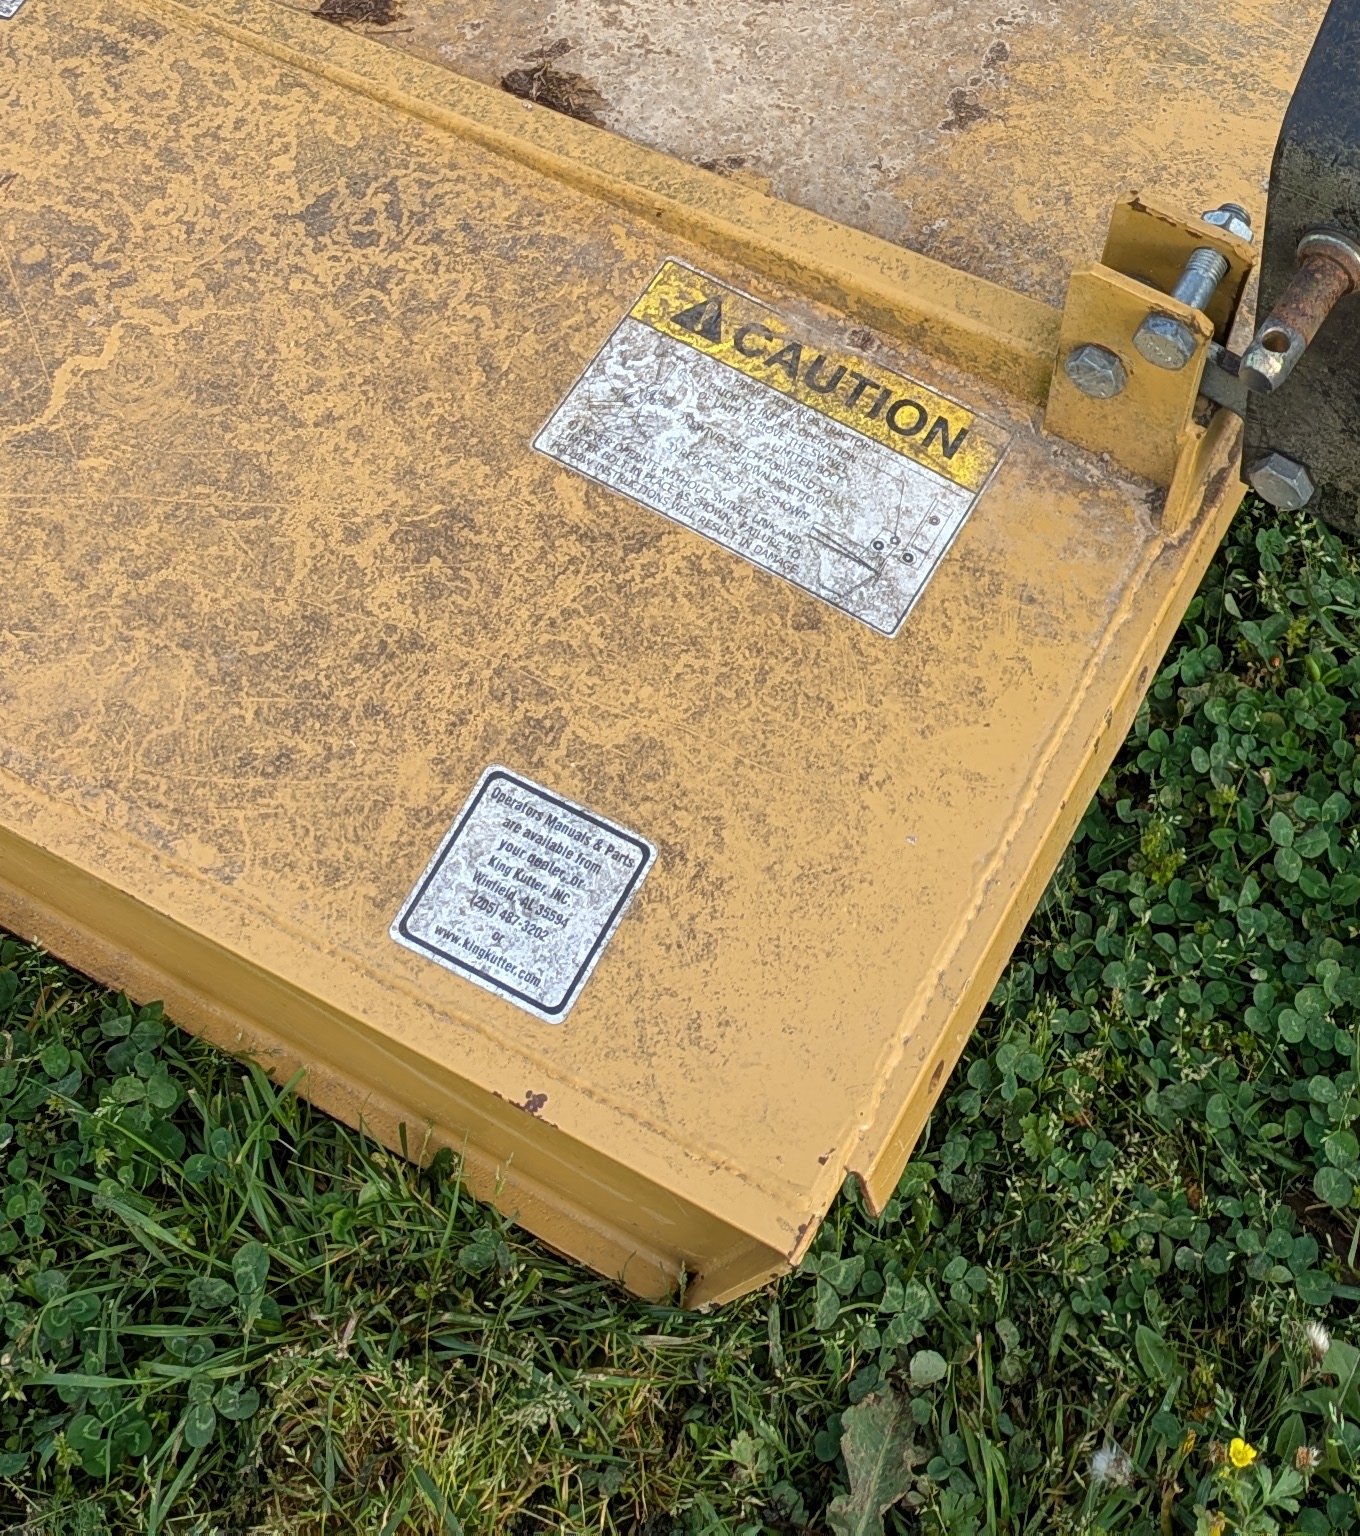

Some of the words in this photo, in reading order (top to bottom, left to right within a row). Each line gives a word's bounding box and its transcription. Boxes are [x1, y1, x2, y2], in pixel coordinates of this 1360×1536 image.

[728, 319, 970, 460] CAUTION
[734, 378, 766, 399] FRONT
[772, 398, 820, 425] TOWARDS
[824, 424, 870, 450] TRACTOR
[697, 392, 712, 403] OF
[744, 416, 785, 439] REMOVE
[787, 437, 808, 451] THE
[811, 450, 848, 472] SWIVEL
[708, 383, 738, 402] PRIOR
[742, 400, 756, 411] TO
[759, 408, 795, 430] INITIAL
[798, 429, 857, 462] OPERATION
[580, 426, 611, 446] NEVER
[614, 443, 659, 470] OPERATE
[661, 468, 708, 496] WITHOUT
[712, 494, 749, 516] SWIVEL
[751, 514, 778, 532] LINK
[778, 528, 802, 545] AND
[679, 449, 722, 474] REPLACE
[724, 472, 751, 490] BOLT
[753, 487, 768, 498] AS
[689, 421, 726, 443] SWIVEL
[730, 441, 762, 462] HITCH
[764, 459, 814, 488] FORWARD
[817, 486, 833, 499] TO
[731, 457, 768, 479] SHOWN
[772, 444, 812, 467] LIMITER
[553, 442, 591, 465] FOLLOW
[596, 464, 668, 504] INSTRUCTIONS
[670, 502, 695, 518] WILL
[698, 517, 734, 539] RESULT
[739, 537, 751, 548] IN
[560, 430, 599, 453] LIMITER
[601, 451, 628, 469] BOLT
[629, 466, 642, 476] IN
[644, 473, 674, 493] PLACE
[676, 490, 691, 501] AS
[740, 524, 782, 549] FAILURE
[785, 546, 801, 559] TO
[490, 787, 544, 822] Operators
[544, 815, 592, 844] Manuals
[592, 838, 604, 851] &
[605, 844, 635, 866] Parts
[502, 817, 522, 833] are
[523, 828, 574, 858] available
[574, 852, 602, 873] from
[486, 855, 513, 876] King
[513, 869, 549, 894] Kutter,
[550, 887, 574, 906] INC.
[498, 839, 524, 860] your
[526, 853, 568, 881] dealer,
[569, 875, 584, 888] or
[469, 894, 498, 916] (205)
[499, 909, 548, 940] 487-3202
[471, 871, 519, 902] Winfield,
[520, 896, 536, 910] AL
[536, 904, 568, 927] 35594
[433, 923, 541, 987] www.kingkutter.com
[491, 930, 505, 943] or
